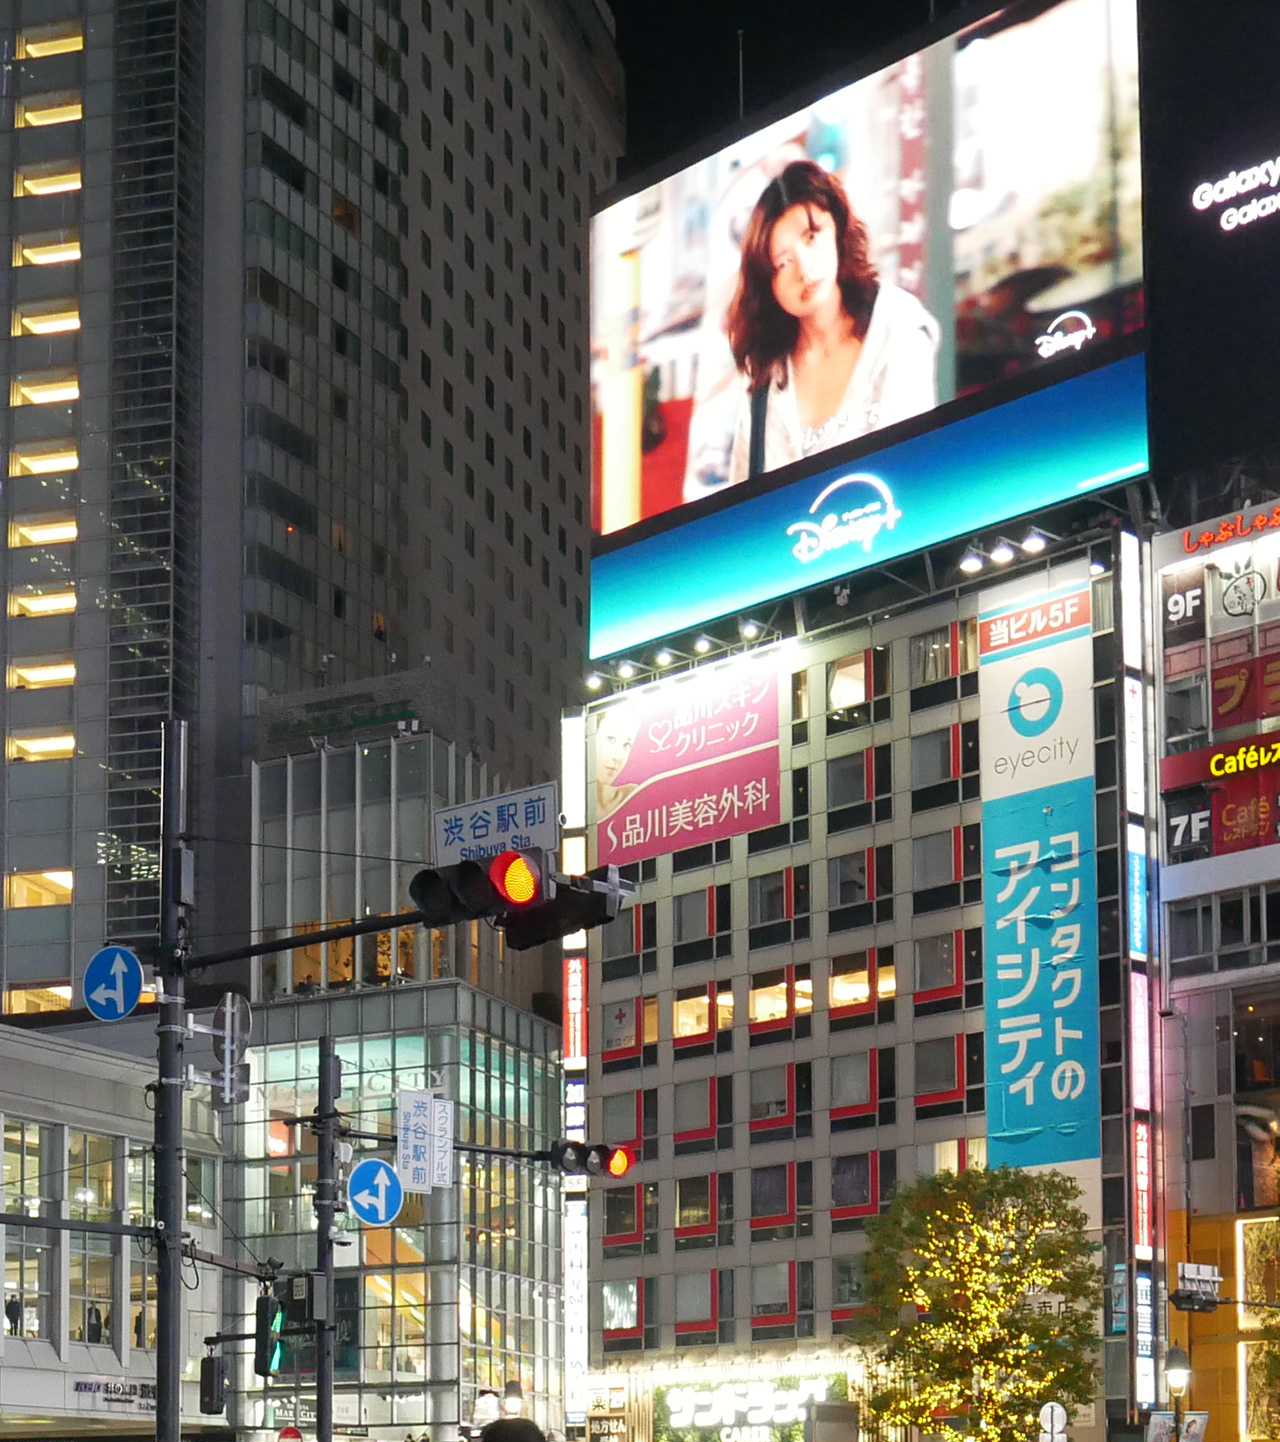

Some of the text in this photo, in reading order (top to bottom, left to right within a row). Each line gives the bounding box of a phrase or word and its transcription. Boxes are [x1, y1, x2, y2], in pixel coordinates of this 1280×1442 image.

[1035, 314, 1096, 360] Disney+
[787, 490, 902, 563] Disney+
[989, 597, 1080, 646] 当ビル5F
[1168, 588, 1202, 621] 9F
[674, 711, 761, 757] クリニック
[993, 735, 1080, 779] eyecity
[443, 795, 547, 846] 渋谷駅前
[621, 776, 770, 849] 品川美容外科
[1170, 809, 1211, 847] 7F
[1222, 796, 1270, 826] Café
[511, 834, 536, 853] Sta.
[993, 839, 1046, 1107] アイシティ
[1049, 830, 1087, 1101] コンタクトの
[367, 1069, 447, 1092] CITY
[402, 1111, 412, 1150] Shibuya
[412, 1099, 428, 1185] 渋谷駅前
[434, 1103, 449, 1184] スクランブル式
[568, 1178, 583, 1188] 5F
[275, 1409, 317, 1418] MAR CIT
[666, 1376, 829, 1427] サンドラッグ
